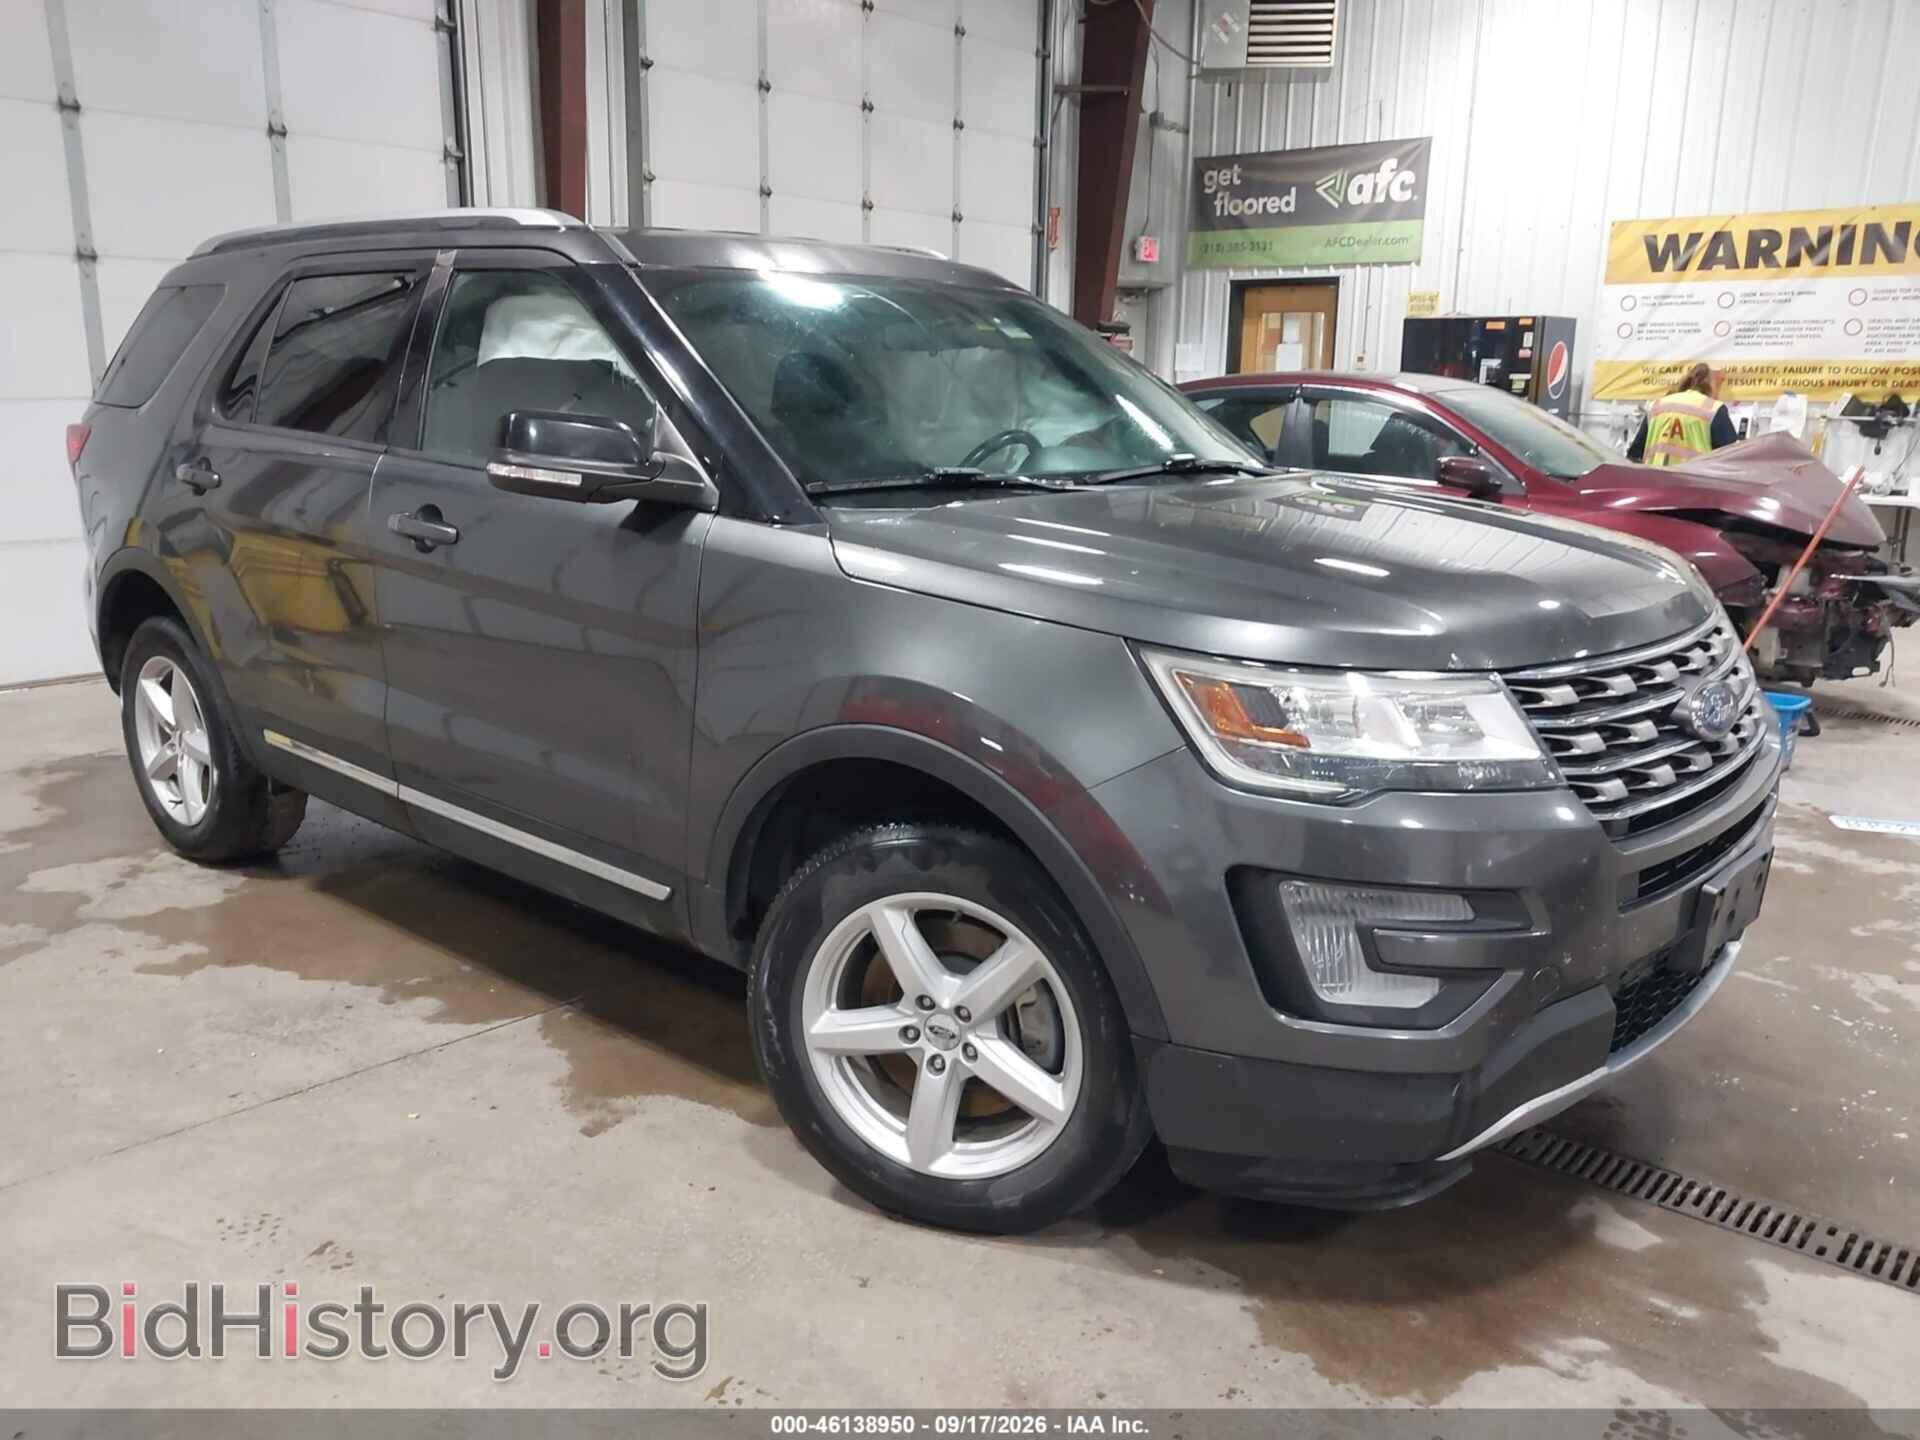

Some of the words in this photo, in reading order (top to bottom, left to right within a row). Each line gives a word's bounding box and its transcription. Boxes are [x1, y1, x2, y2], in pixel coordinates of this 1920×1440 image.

[1203, 164, 1242, 193] get
[1214, 187, 1296, 216] floored
[1644, 221, 1920, 273] WARNIN
[1659, 366, 1682, 374] CARE
[1742, 366, 1779, 374] SAFETY,
[1783, 366, 1823, 374] FAILURE
[1828, 366, 1840, 374] TO
[1844, 366, 1889, 375] FOLLOW
[1728, 378, 1762, 386] RESULT
[1767, 379, 1777, 387] IN
[1781, 379, 1825, 387] SERIOUS
[1828, 379, 1868, 387] INJURY
[1871, 379, 1887, 387] OR
